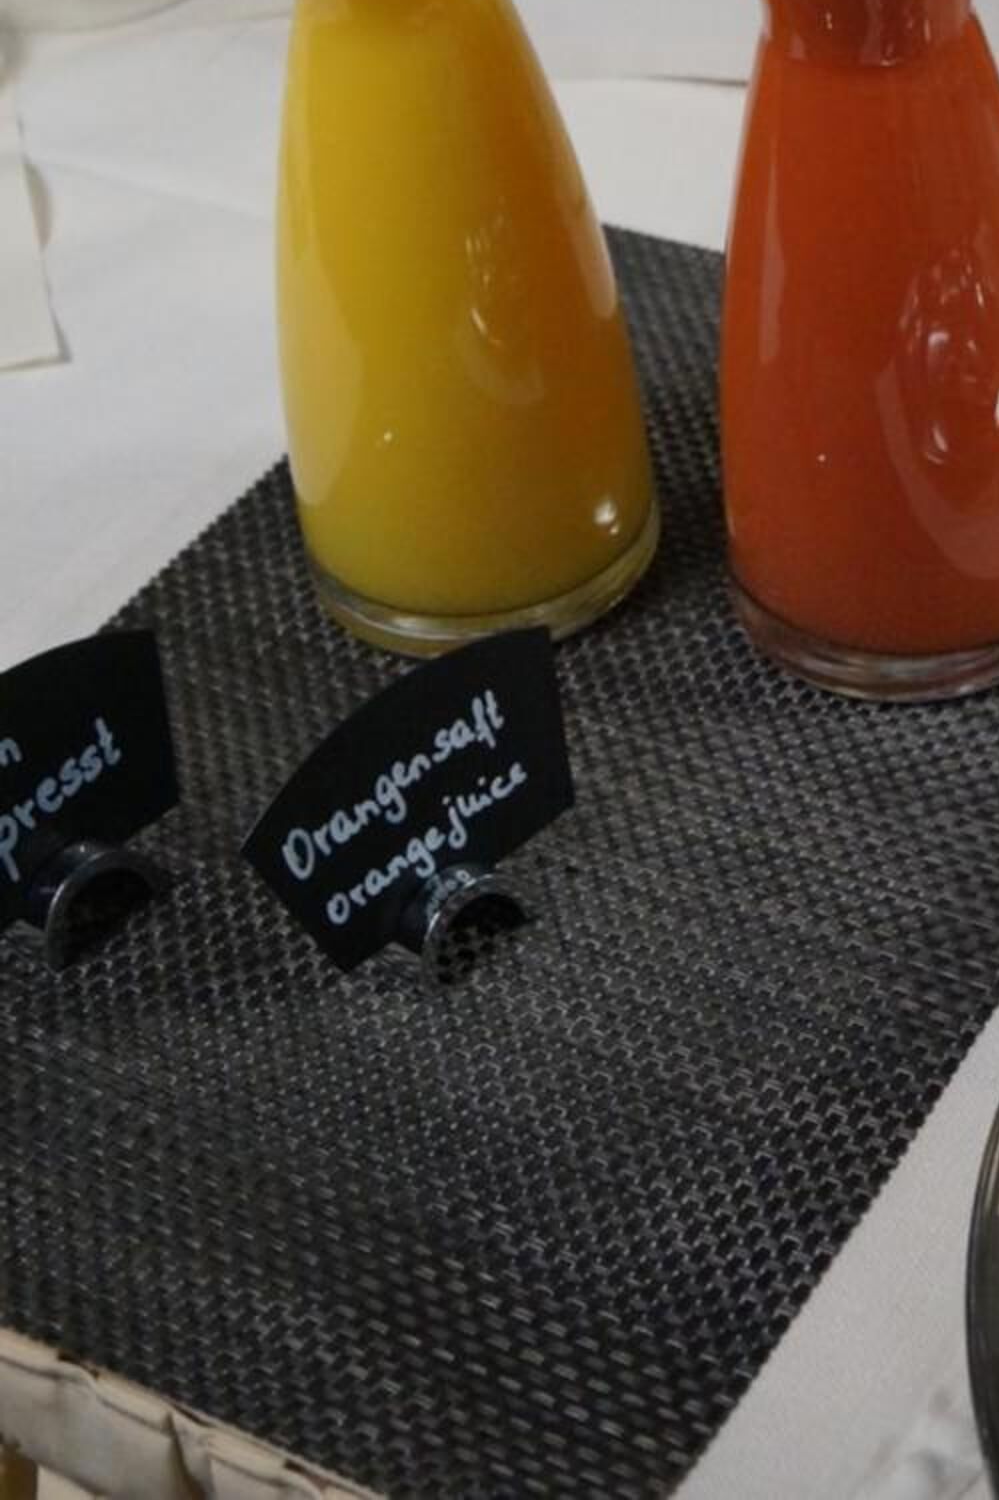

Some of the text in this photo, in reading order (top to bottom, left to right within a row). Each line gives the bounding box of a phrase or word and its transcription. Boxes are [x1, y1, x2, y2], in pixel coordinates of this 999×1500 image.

[0, 715, 122, 884] presst
[281, 689, 506, 880] Orangensaft
[325, 830, 446, 925] orange
[445, 760, 528, 849] juice
